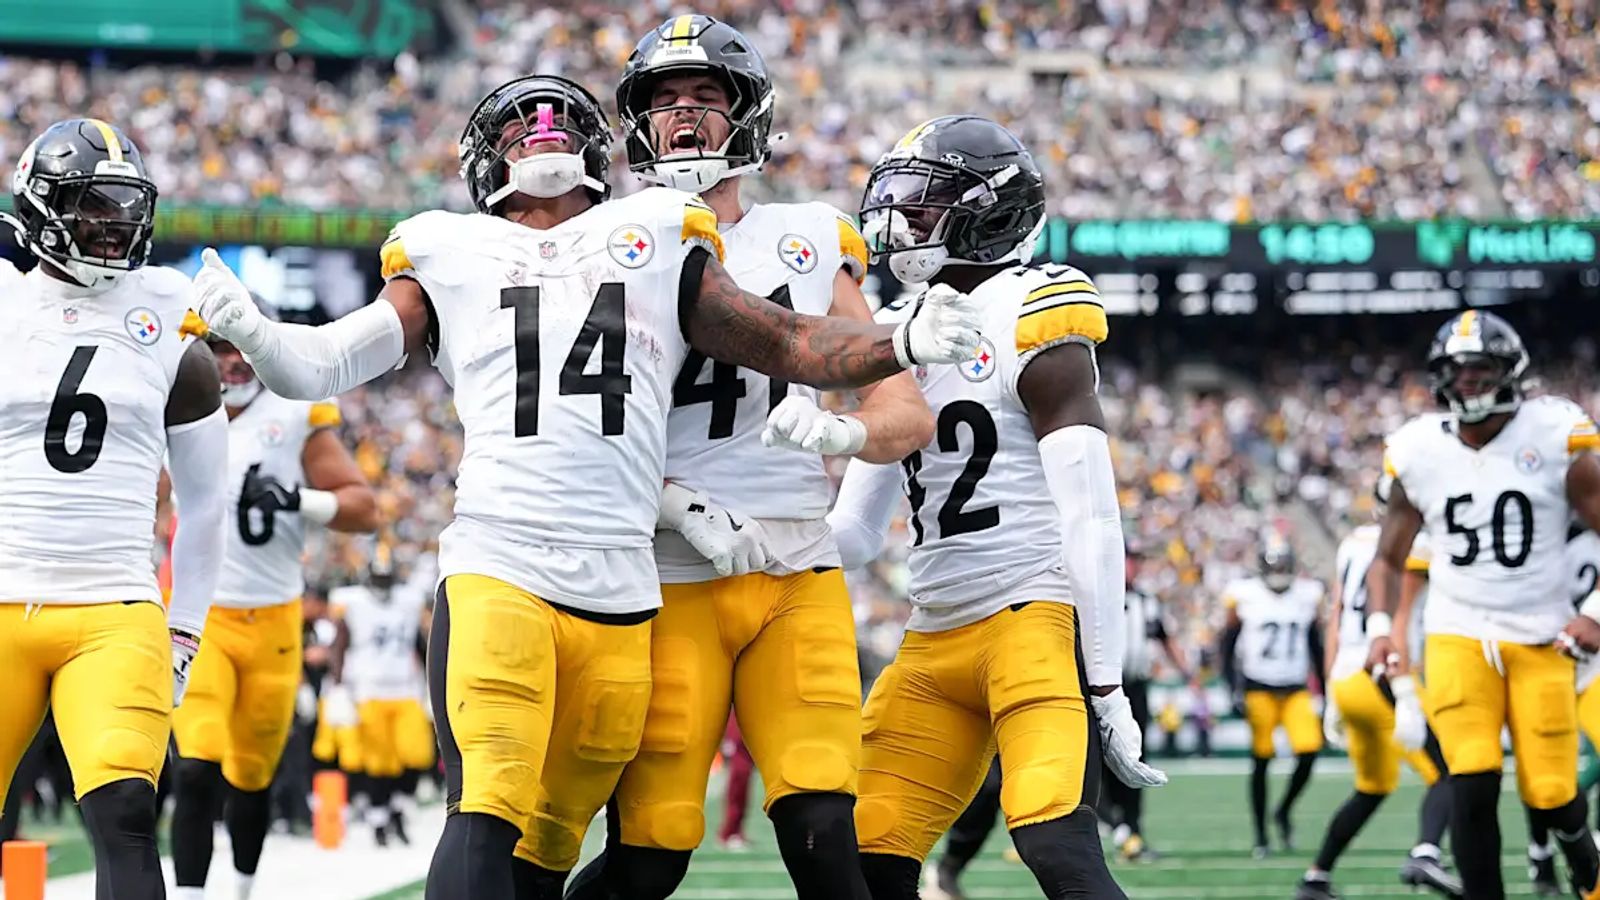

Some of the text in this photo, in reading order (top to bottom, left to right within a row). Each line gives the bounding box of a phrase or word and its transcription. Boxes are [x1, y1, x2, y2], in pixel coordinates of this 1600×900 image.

[1468, 224, 1596, 264] MetLife
[500, 282, 632, 438] 14
[44, 345, 108, 474] 6
[1445, 490, 1534, 568] 50
[1260, 621, 1299, 661] 21
